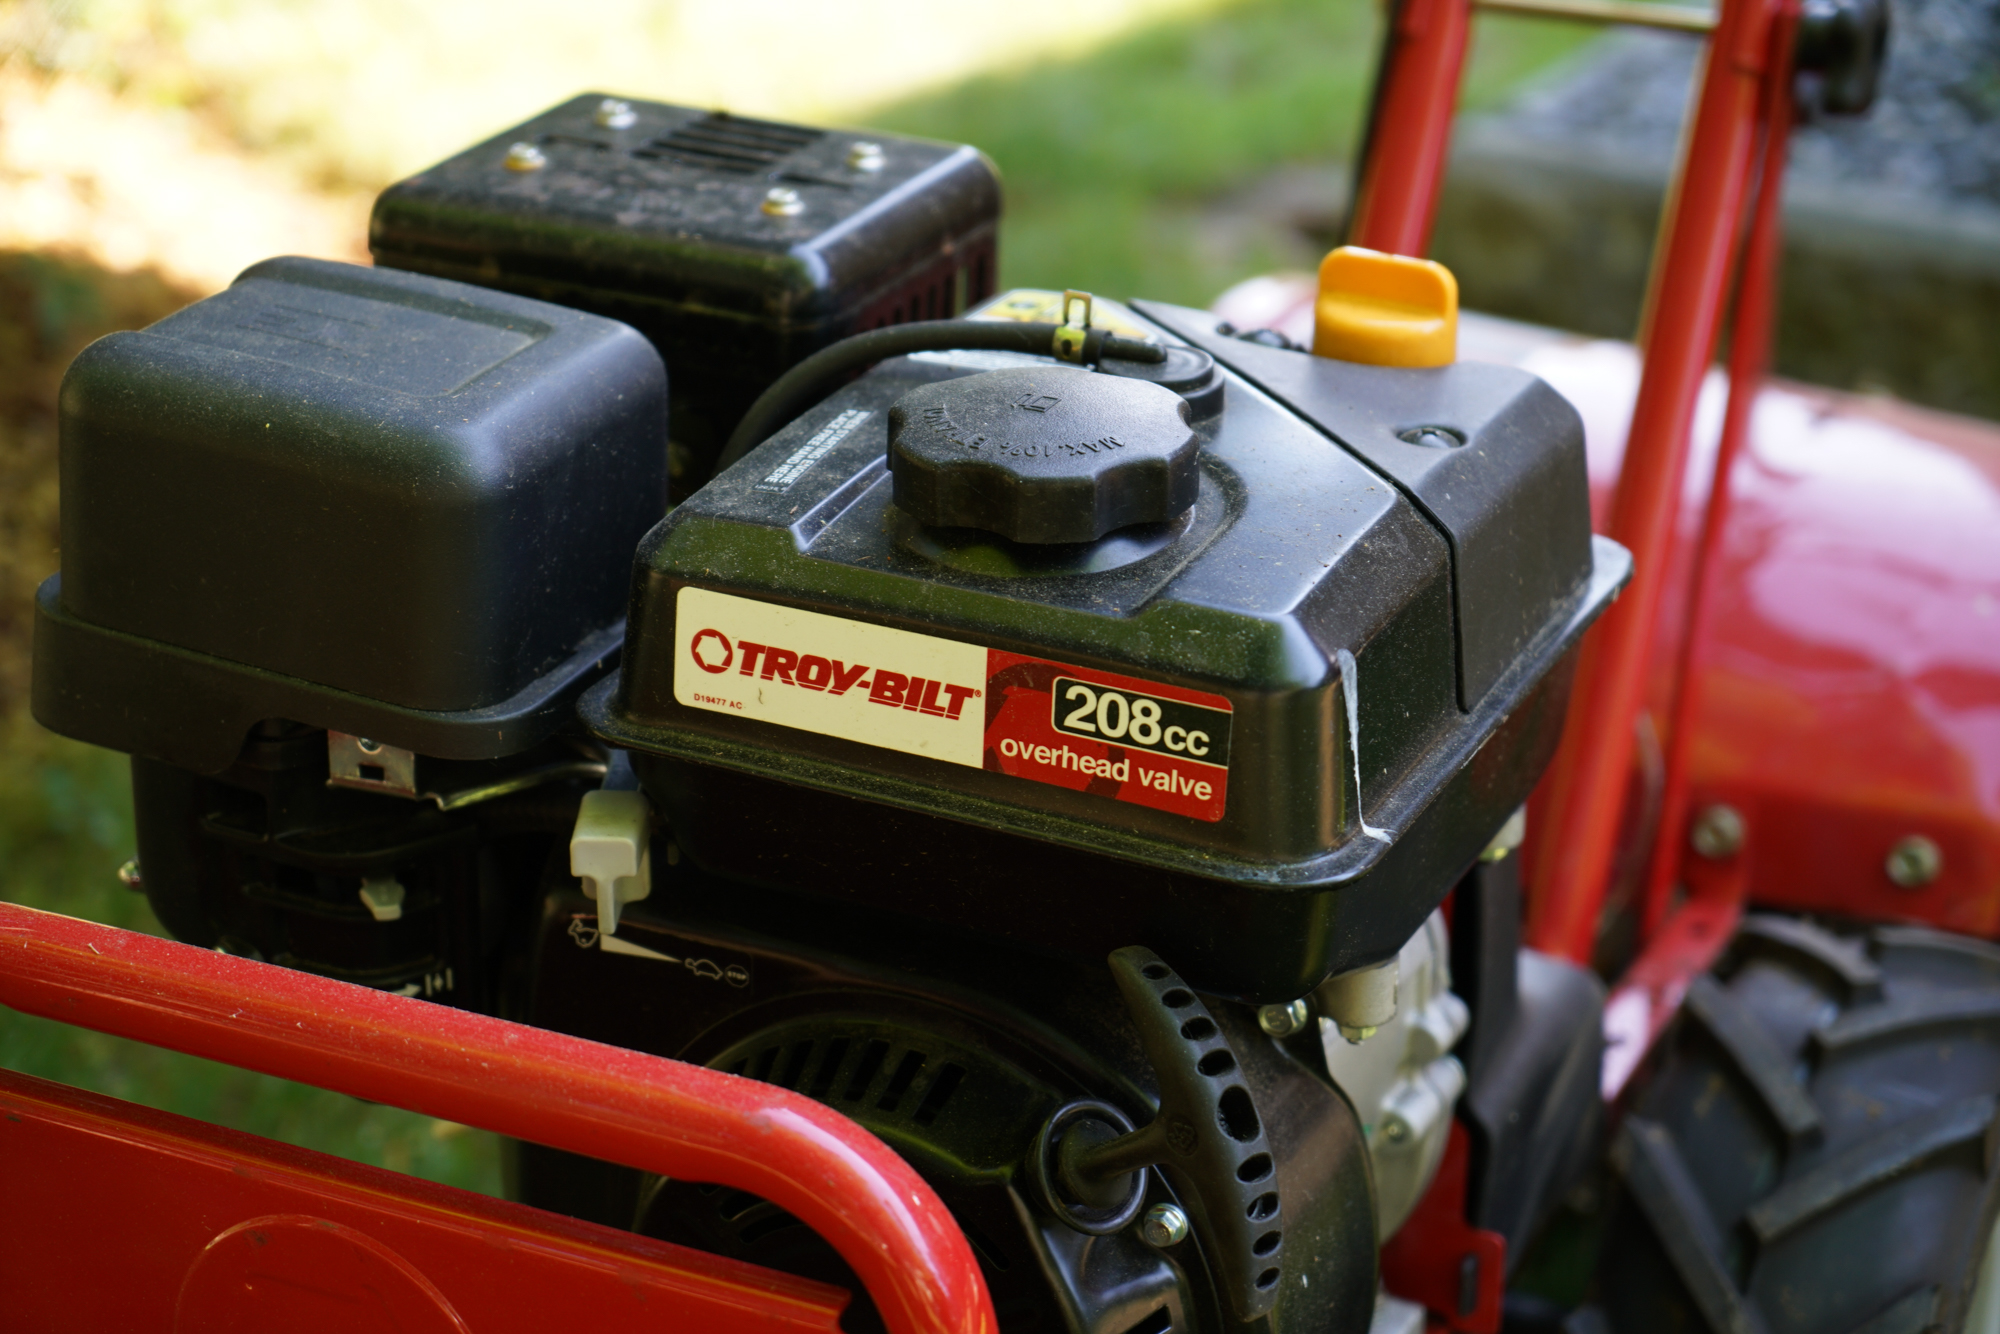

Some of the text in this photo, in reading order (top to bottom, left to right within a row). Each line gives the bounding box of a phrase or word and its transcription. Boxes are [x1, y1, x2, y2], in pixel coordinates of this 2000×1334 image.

[786, 445, 815, 463] HAND
[764, 463, 794, 482] HERE
[779, 459, 815, 484] ENGINE
[694, 693, 742, 710] D19477 AC
[1000, 738, 1213, 800] overhead valve
[727, 970, 747, 980] STOP
